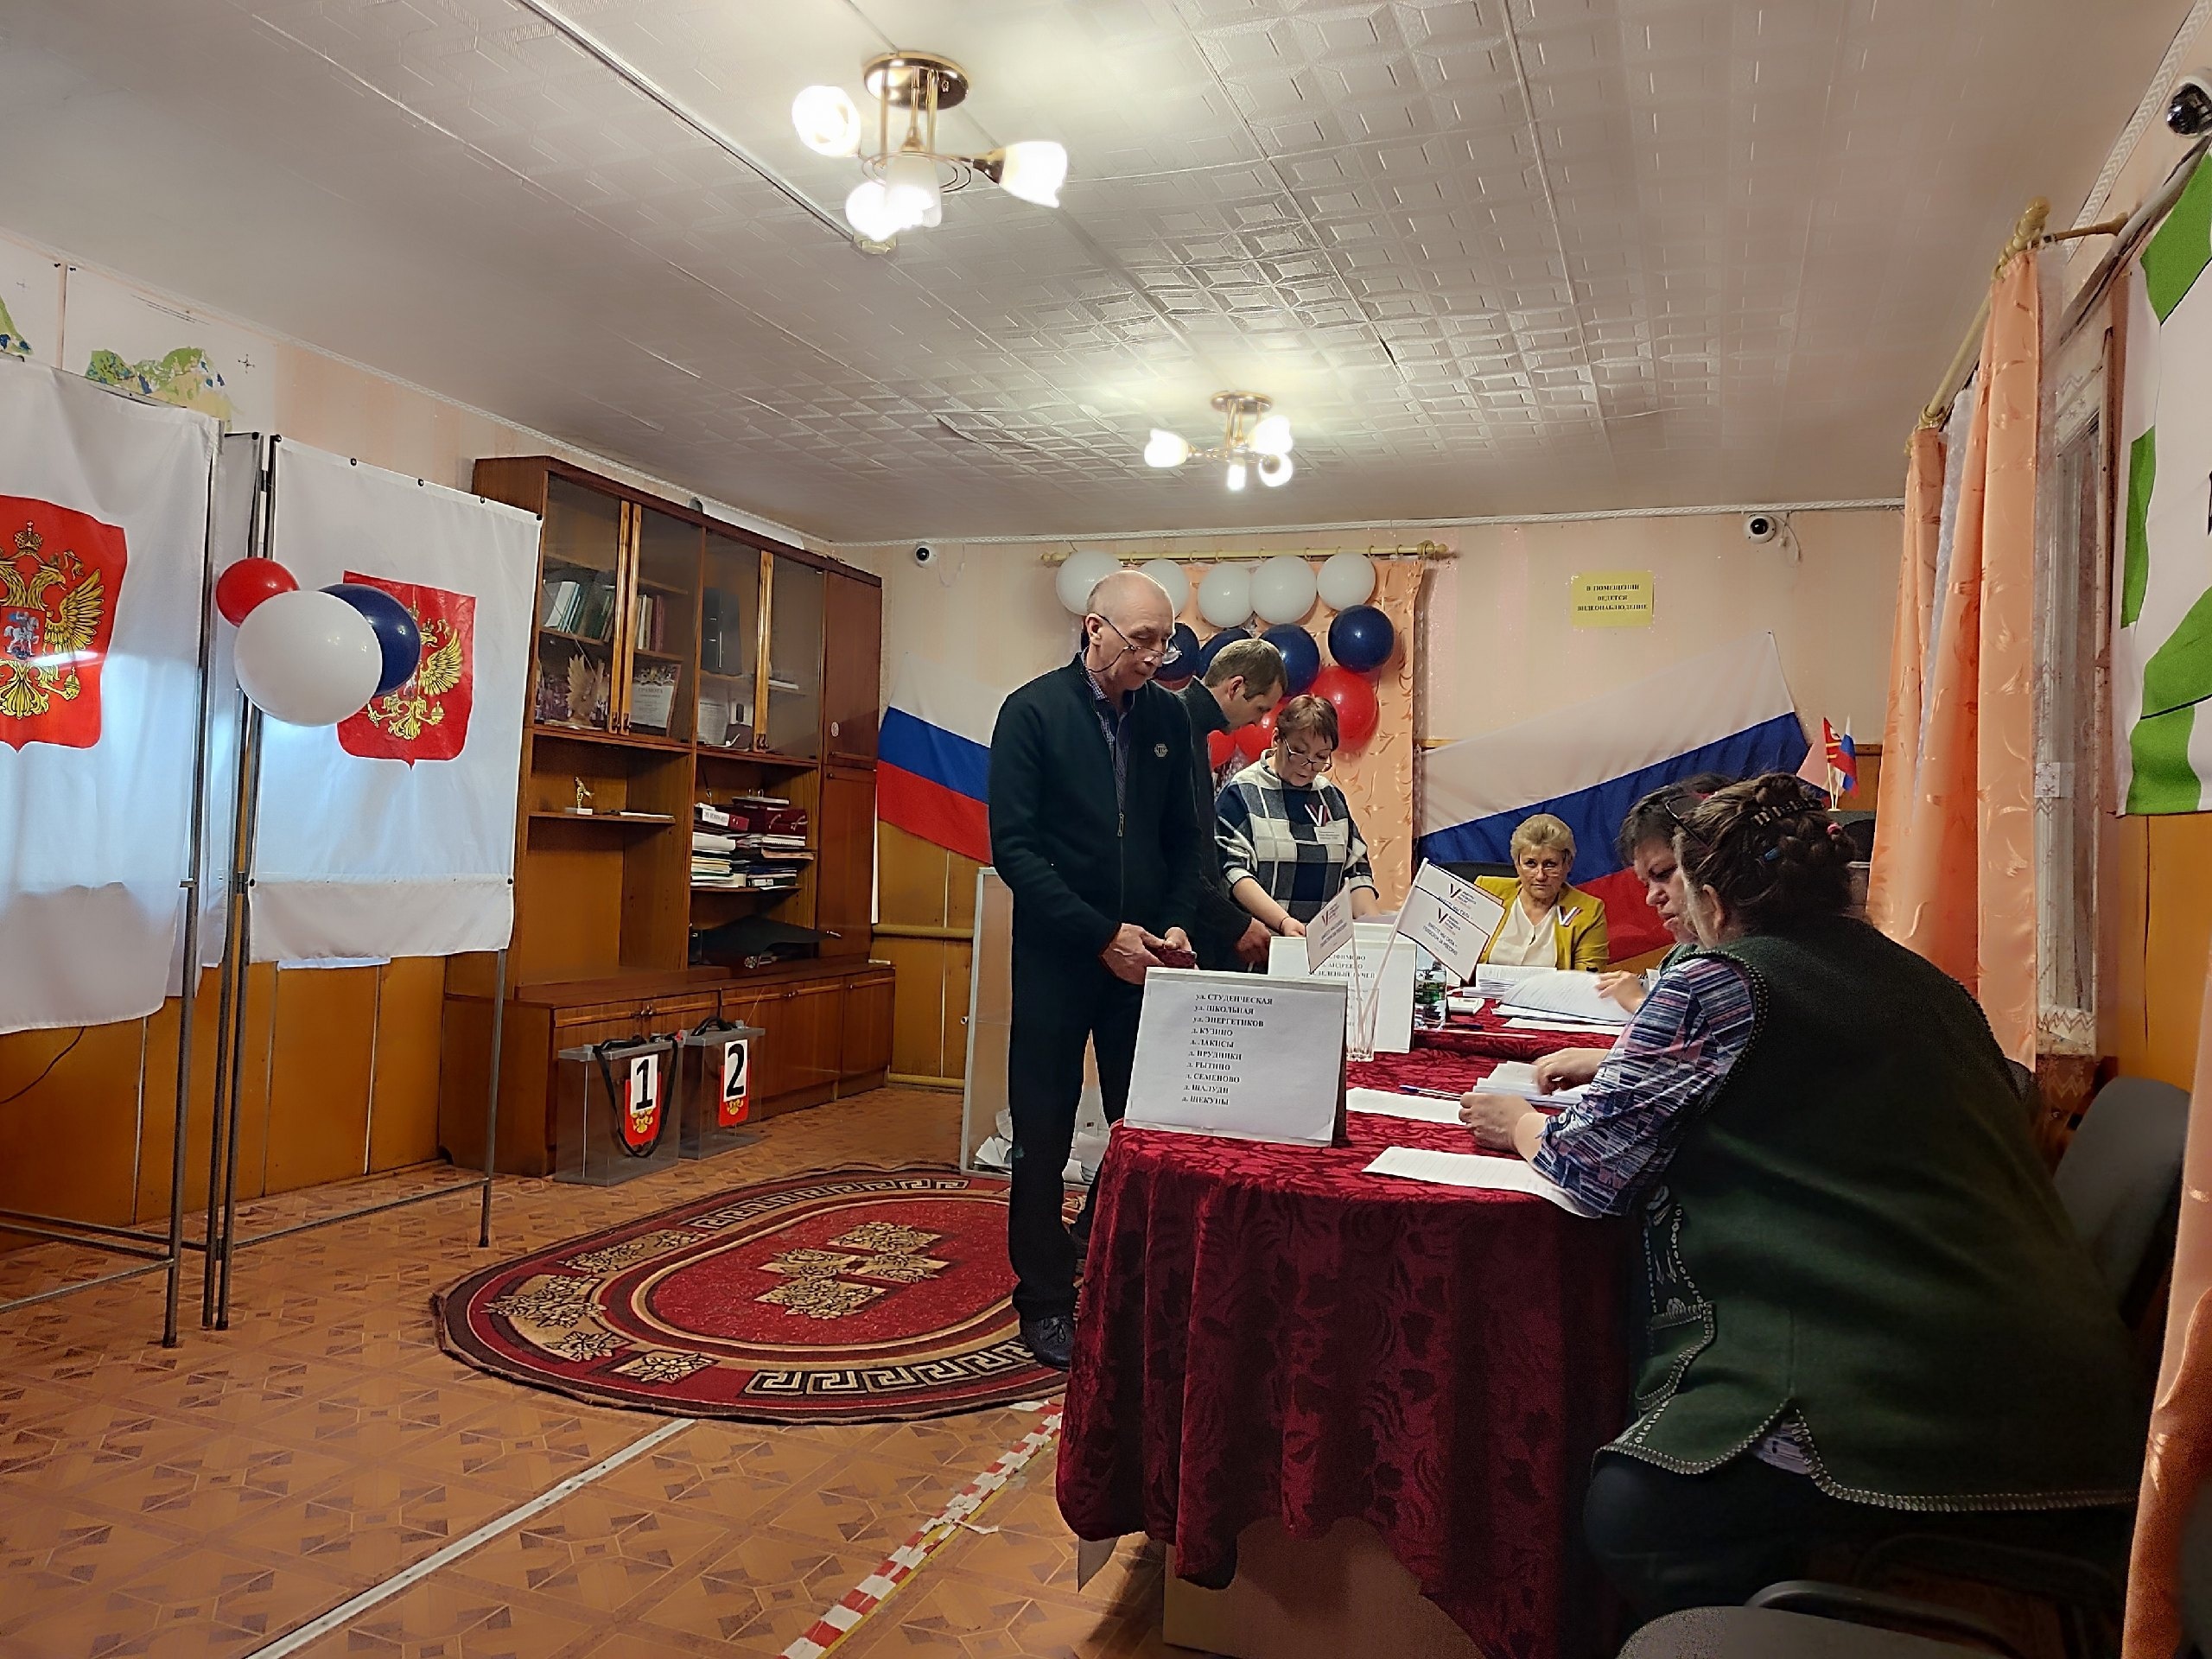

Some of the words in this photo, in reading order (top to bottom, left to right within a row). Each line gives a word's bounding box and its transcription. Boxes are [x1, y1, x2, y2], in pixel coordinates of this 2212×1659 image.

[1207, 994, 1273, 1005] СТУДЕНЧЕСКАЯ
[1206, 1005, 1254, 1014] ШКОЛЬНАЯ
[1205, 1016, 1264, 1027] ЭНЕРГЕТИКОВ
[1197, 1051, 1243, 1060] ПРУДНИКИ
[726, 1043, 745, 1097] 2
[635, 1058, 653, 1109] 1
[1193, 1073, 1240, 1083] СЕМЕНОВО
